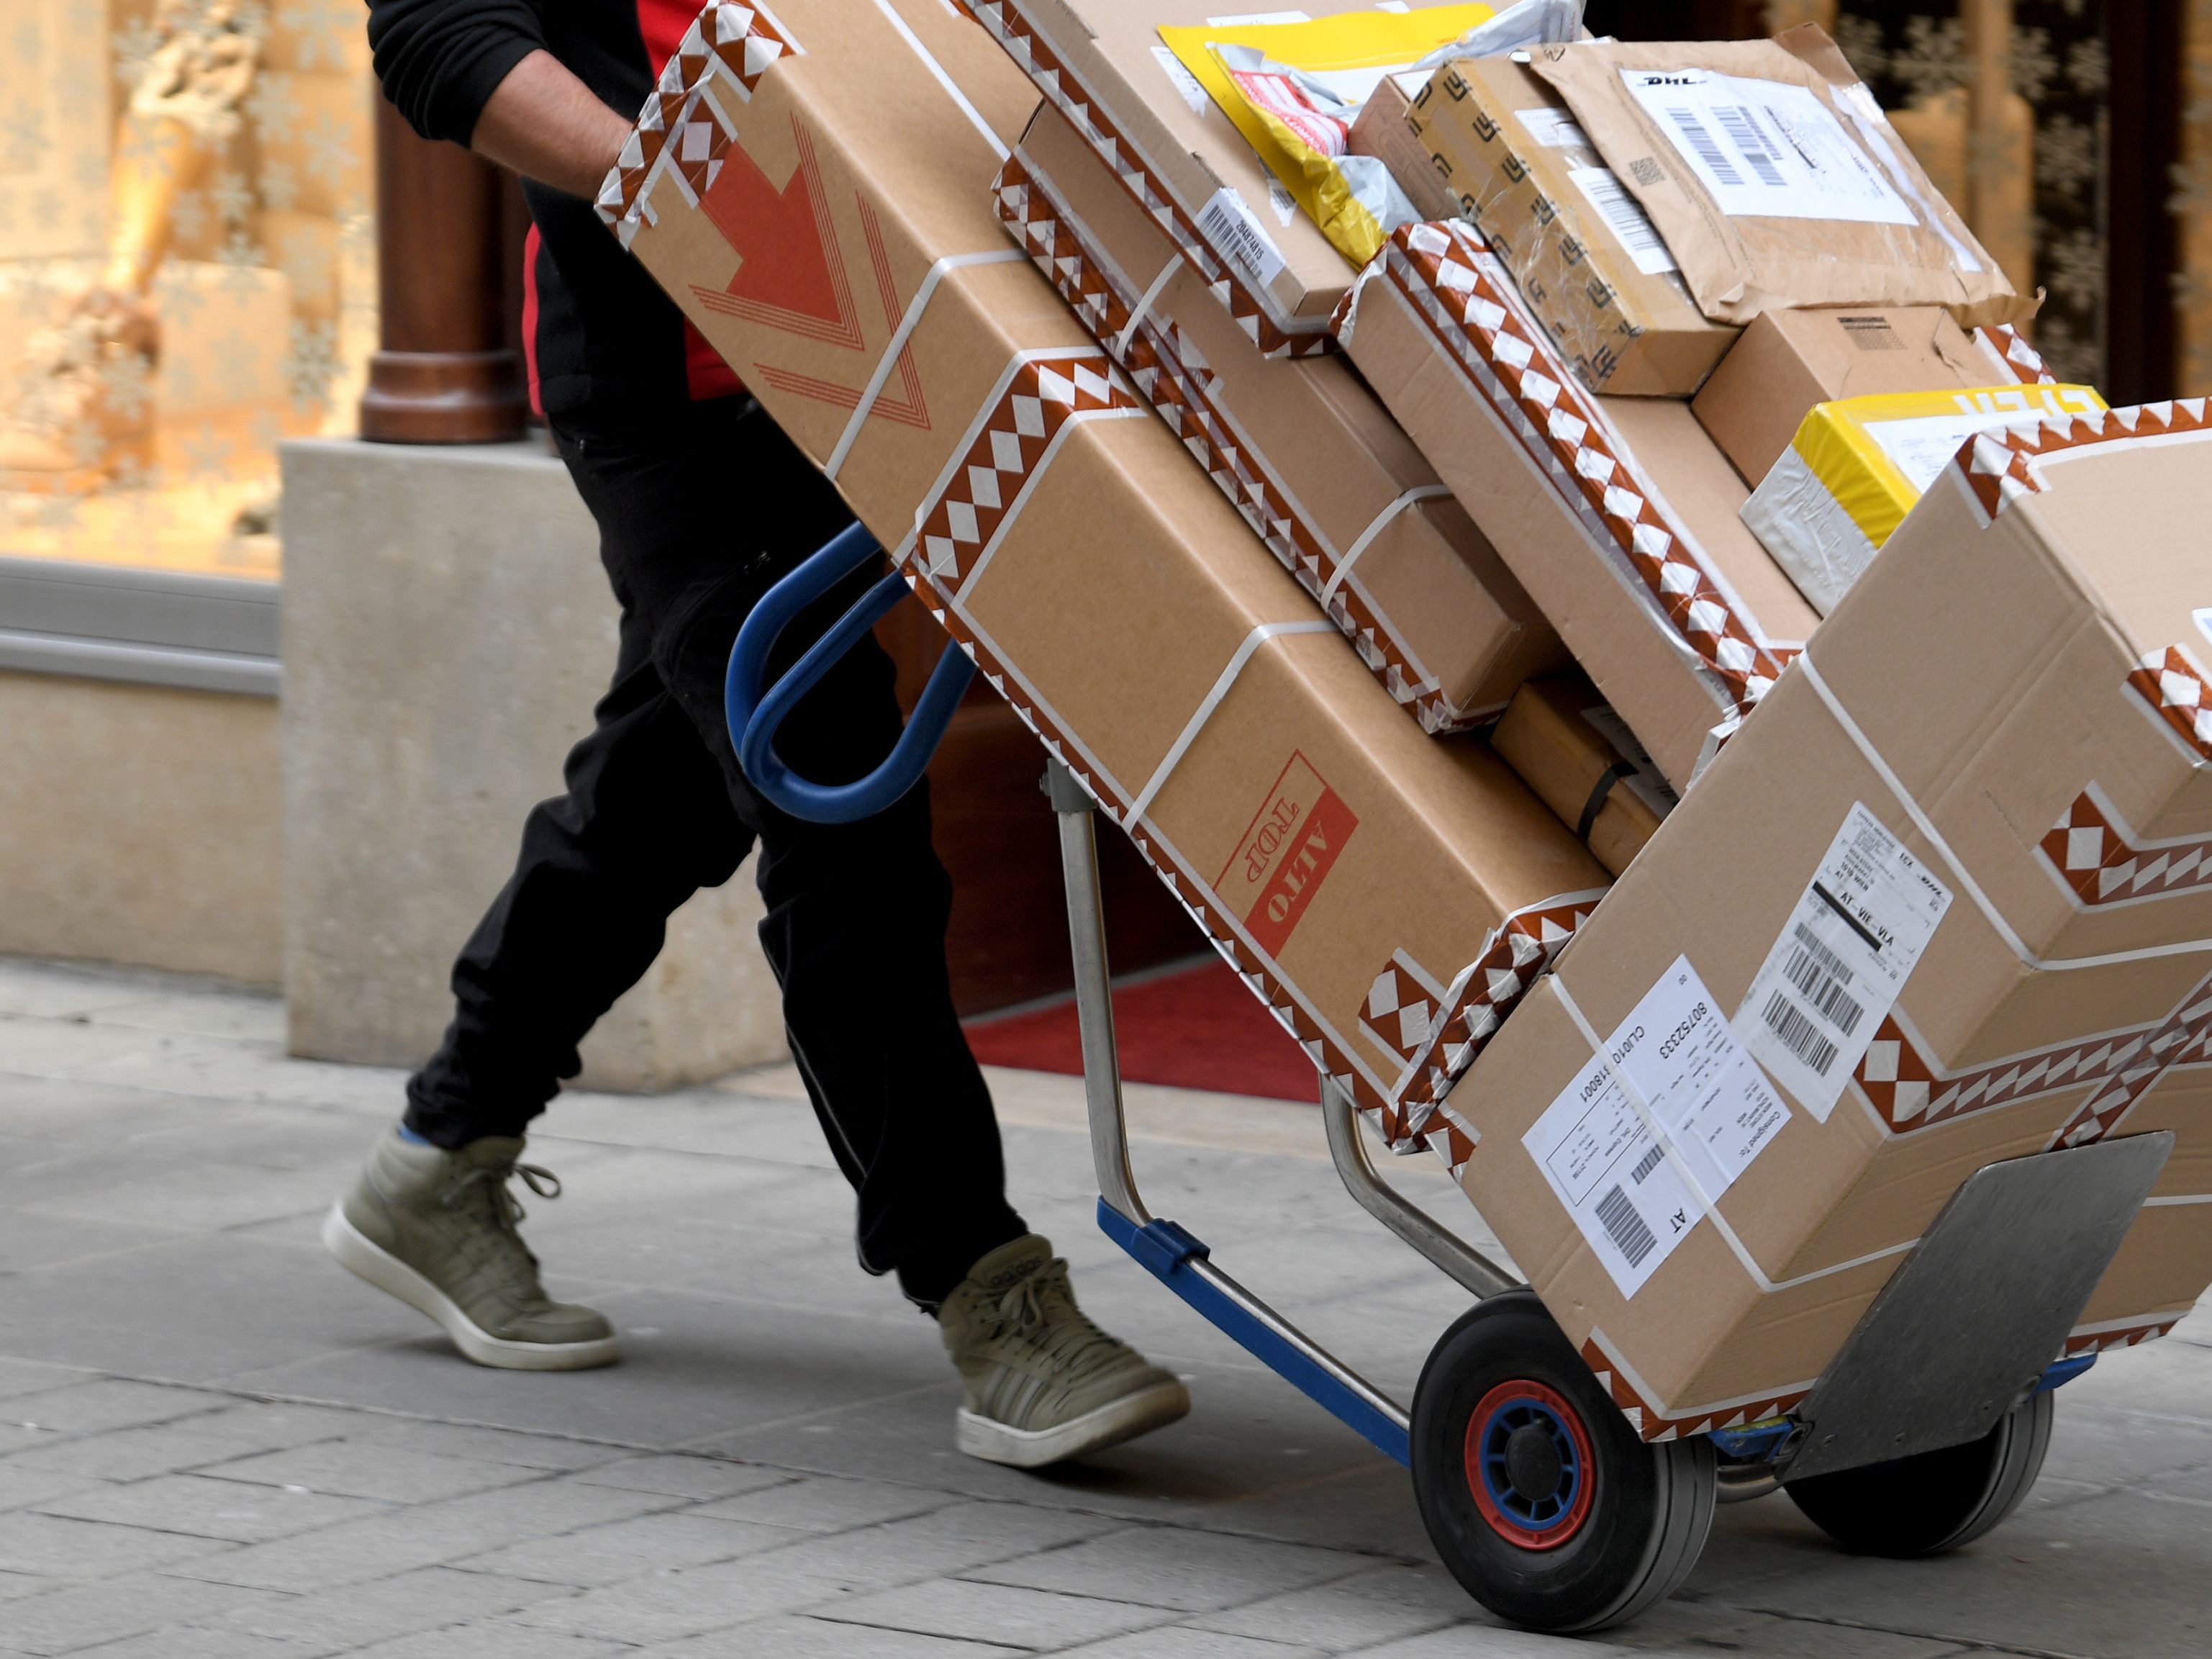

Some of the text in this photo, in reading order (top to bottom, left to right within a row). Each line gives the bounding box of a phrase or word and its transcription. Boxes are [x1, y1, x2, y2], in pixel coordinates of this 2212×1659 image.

[1644, 76, 1697, 86] DHL
[1236, 220, 1265, 260] 204874815
[1267, 821, 1330, 922] ALTO
[1659, 1001, 1708, 1060] 80752333
[1579, 1025, 1646, 1103] CLI010318001
[1746, 1108, 1781, 1149] Consigned
[1667, 1206, 1689, 1234] AT
